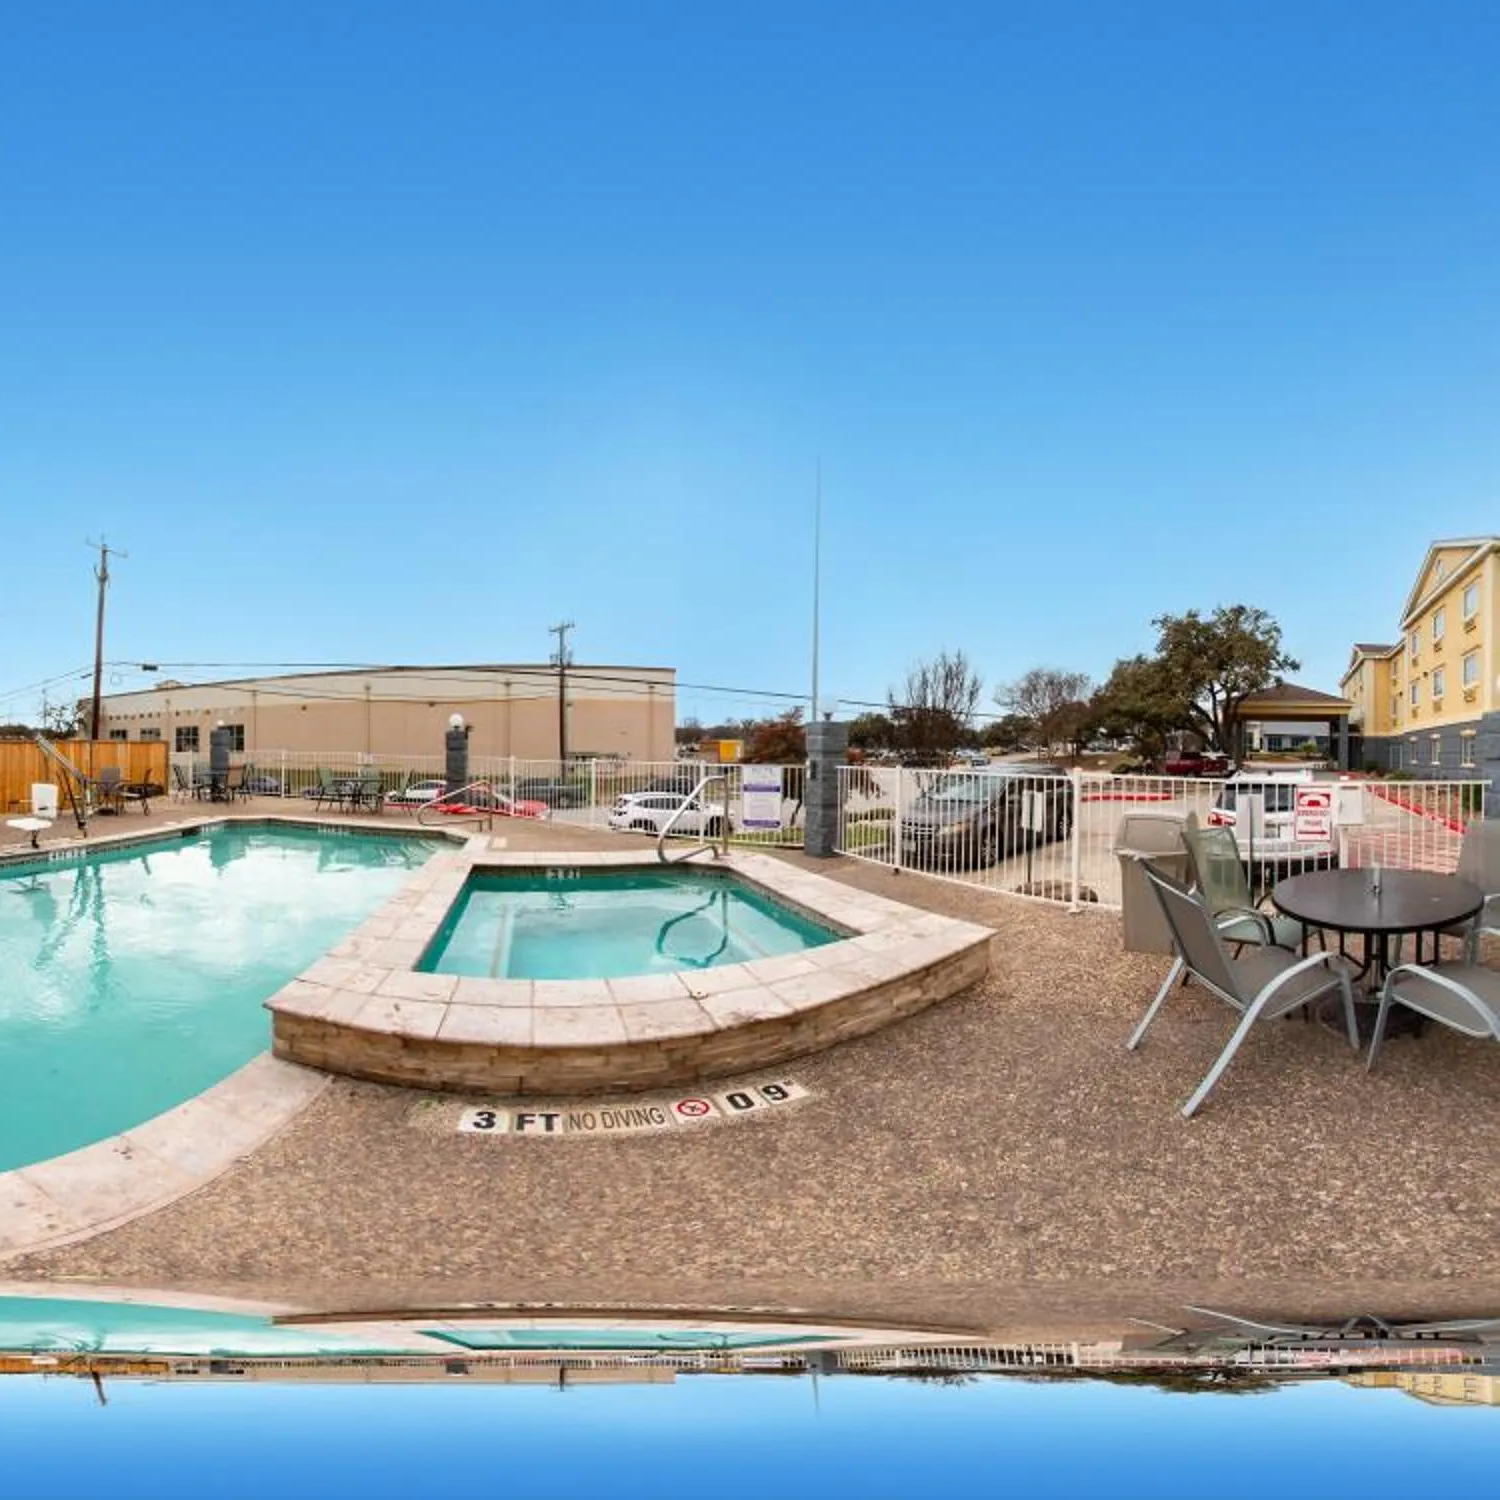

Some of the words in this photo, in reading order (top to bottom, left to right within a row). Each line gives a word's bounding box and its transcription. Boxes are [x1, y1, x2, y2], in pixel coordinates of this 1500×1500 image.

[473, 1111, 497, 1129] 3
[516, 1113, 560, 1131] FT
[569, 1113, 597, 1131] NO
[601, 1107, 666, 1130] DIVING
